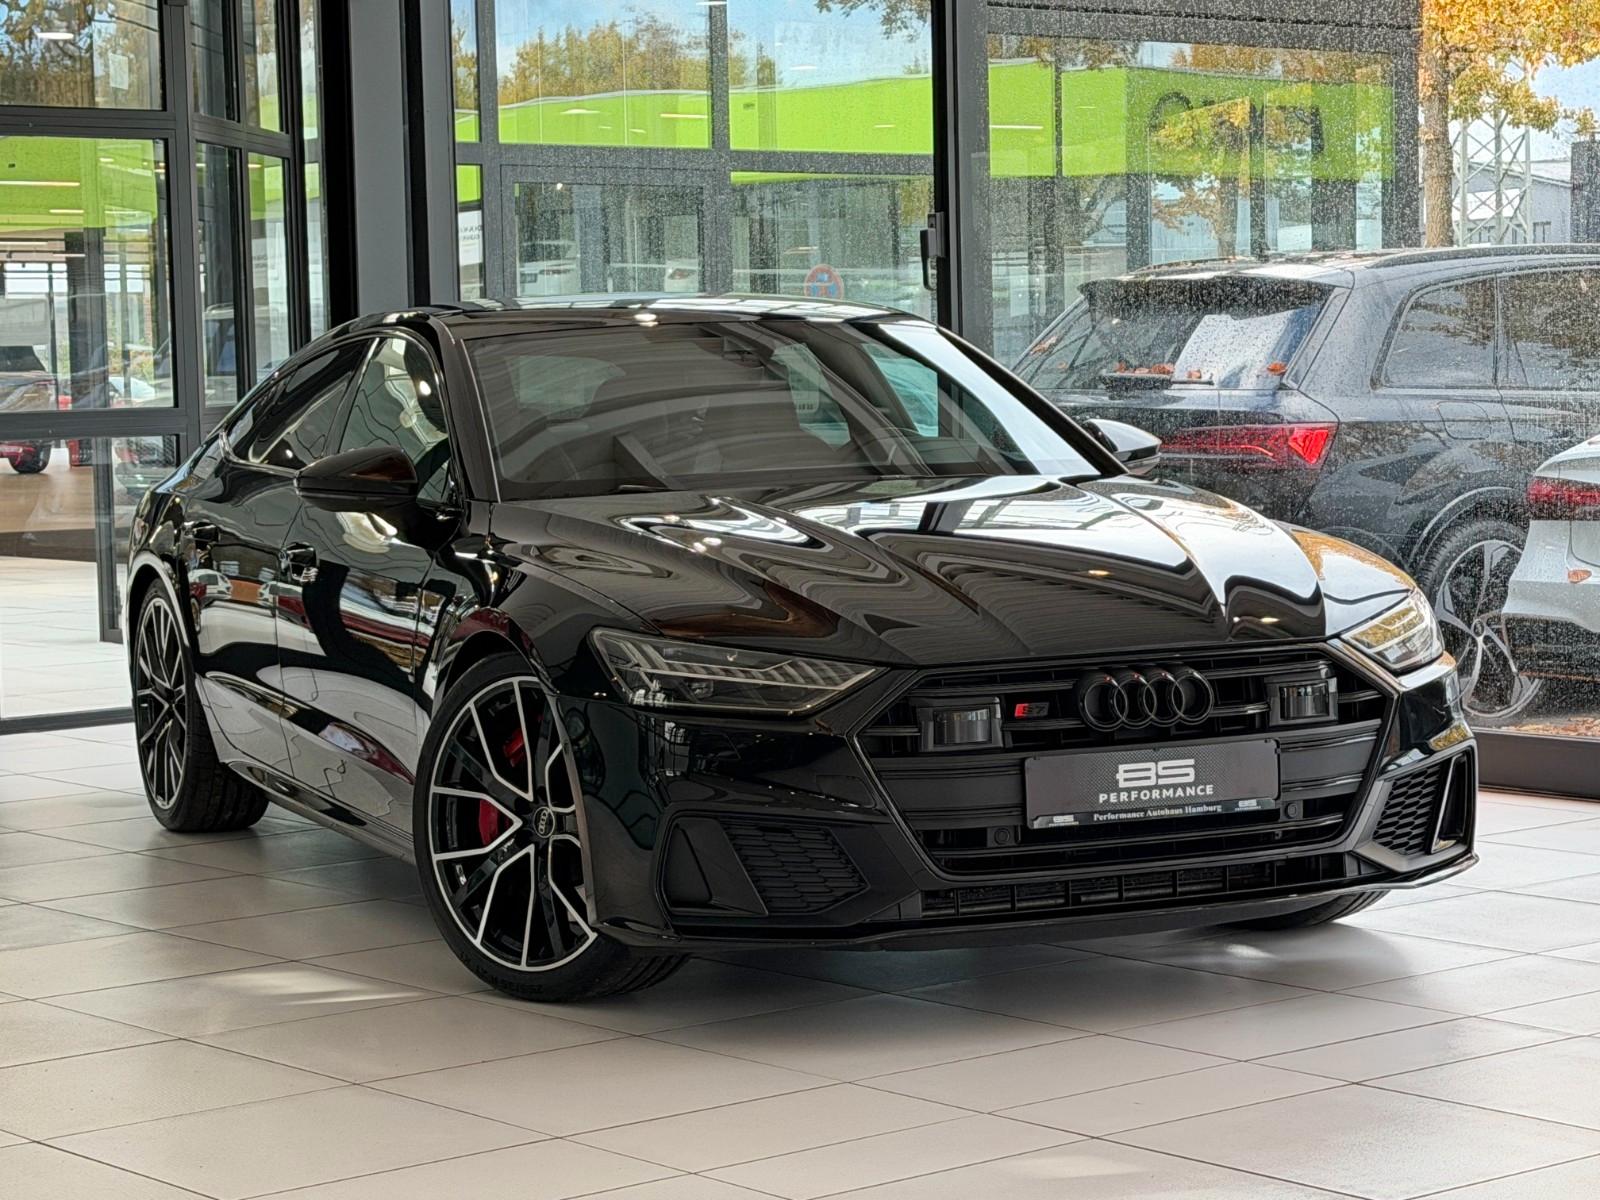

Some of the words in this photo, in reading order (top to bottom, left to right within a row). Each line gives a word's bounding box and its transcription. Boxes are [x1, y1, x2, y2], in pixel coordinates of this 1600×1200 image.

[1099, 784, 1214, 803] PERFORMANCE
[1094, 810, 1145, 821] Performance
[1146, 806, 1184, 818] Autohaus
[1185, 804, 1222, 815] Hamburg
